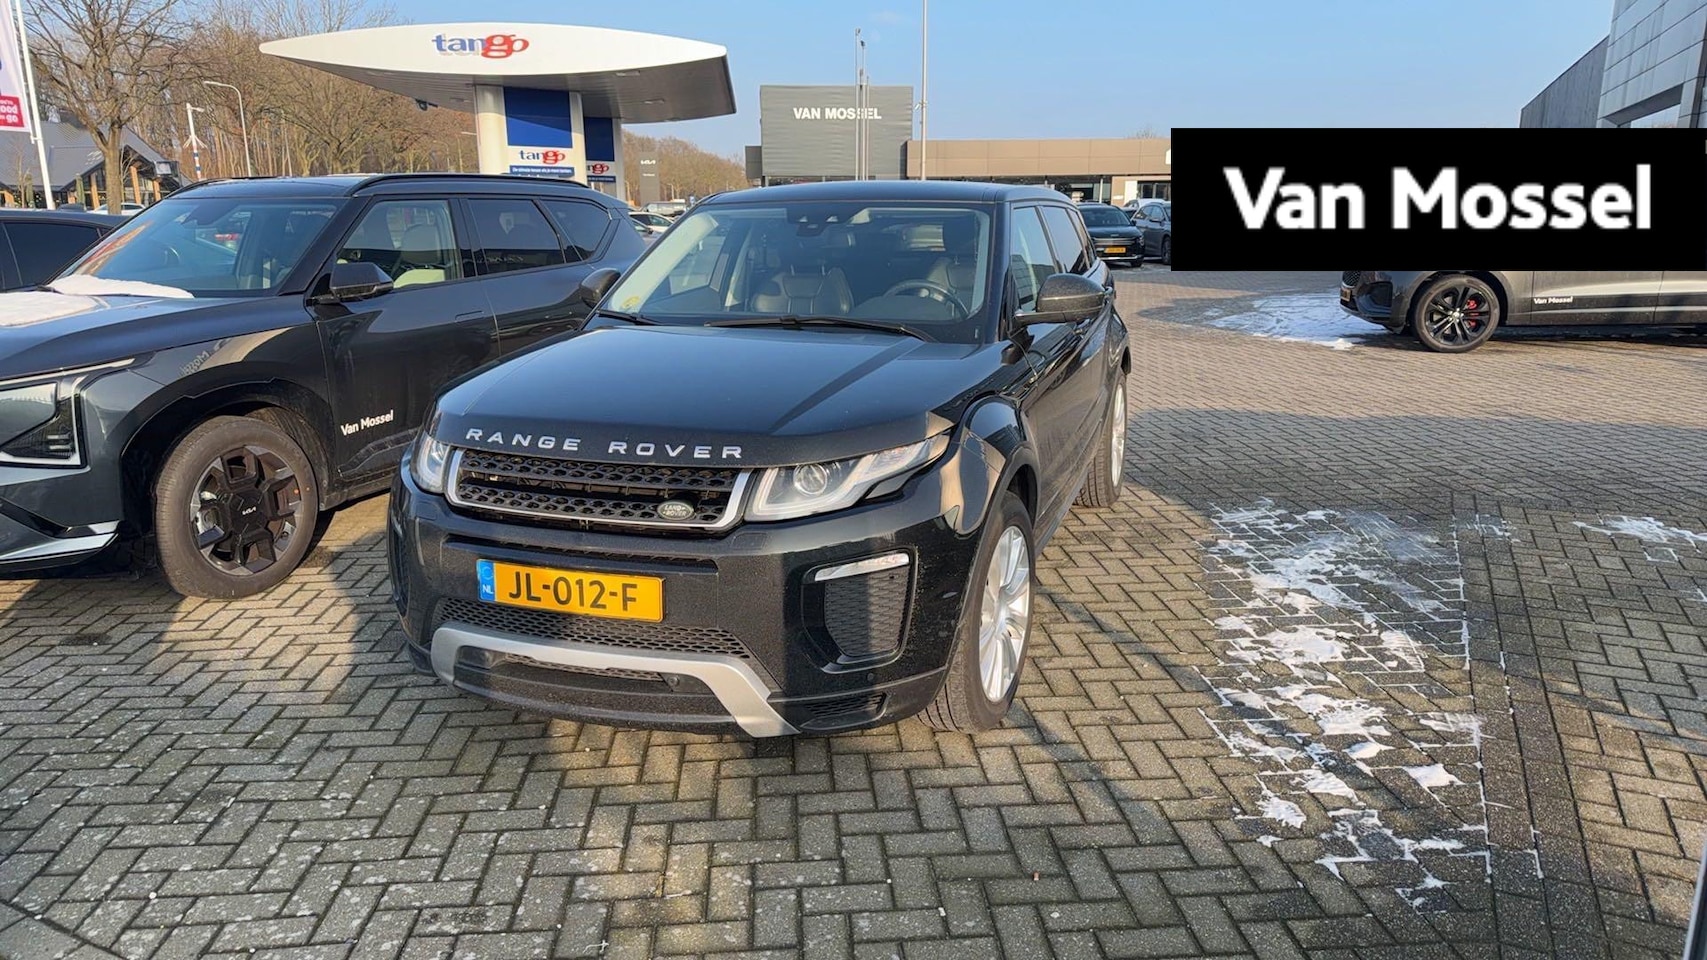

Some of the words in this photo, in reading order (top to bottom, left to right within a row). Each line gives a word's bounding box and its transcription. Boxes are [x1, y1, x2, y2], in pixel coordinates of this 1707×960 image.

[431, 34, 530, 59] tango
[793, 107, 820, 119] VAN
[519, 149, 566, 165] tango
[340, 422, 359, 436] Van
[360, 409, 394, 430] Mossel
[465, 428, 581, 451] RANGE
[608, 441, 742, 459] ROVER
[482, 584, 494, 594] NL
[508, 571, 638, 612] JL-012-F
